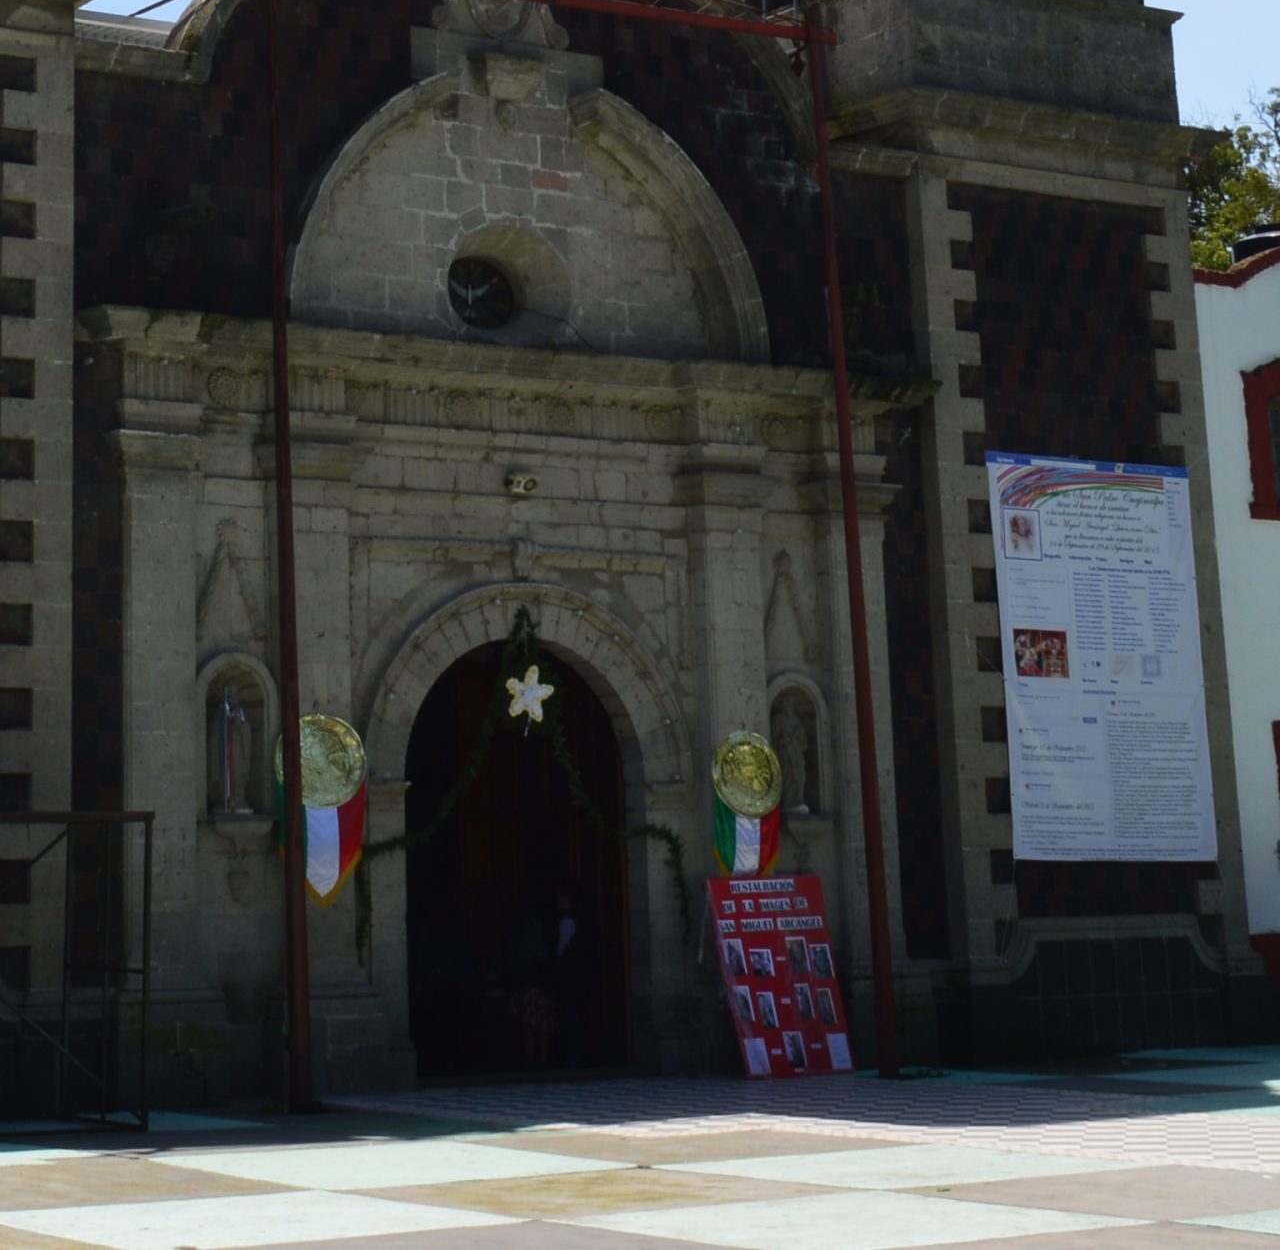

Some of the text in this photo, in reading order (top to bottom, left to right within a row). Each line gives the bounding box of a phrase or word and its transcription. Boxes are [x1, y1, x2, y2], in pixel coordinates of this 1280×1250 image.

[724, 902, 734, 913] DE
[743, 902, 754, 912] LA
[760, 900, 791, 911] IMAGEN
[720, 922, 736, 932] SAN
[741, 920, 773, 931] MIGUEL
